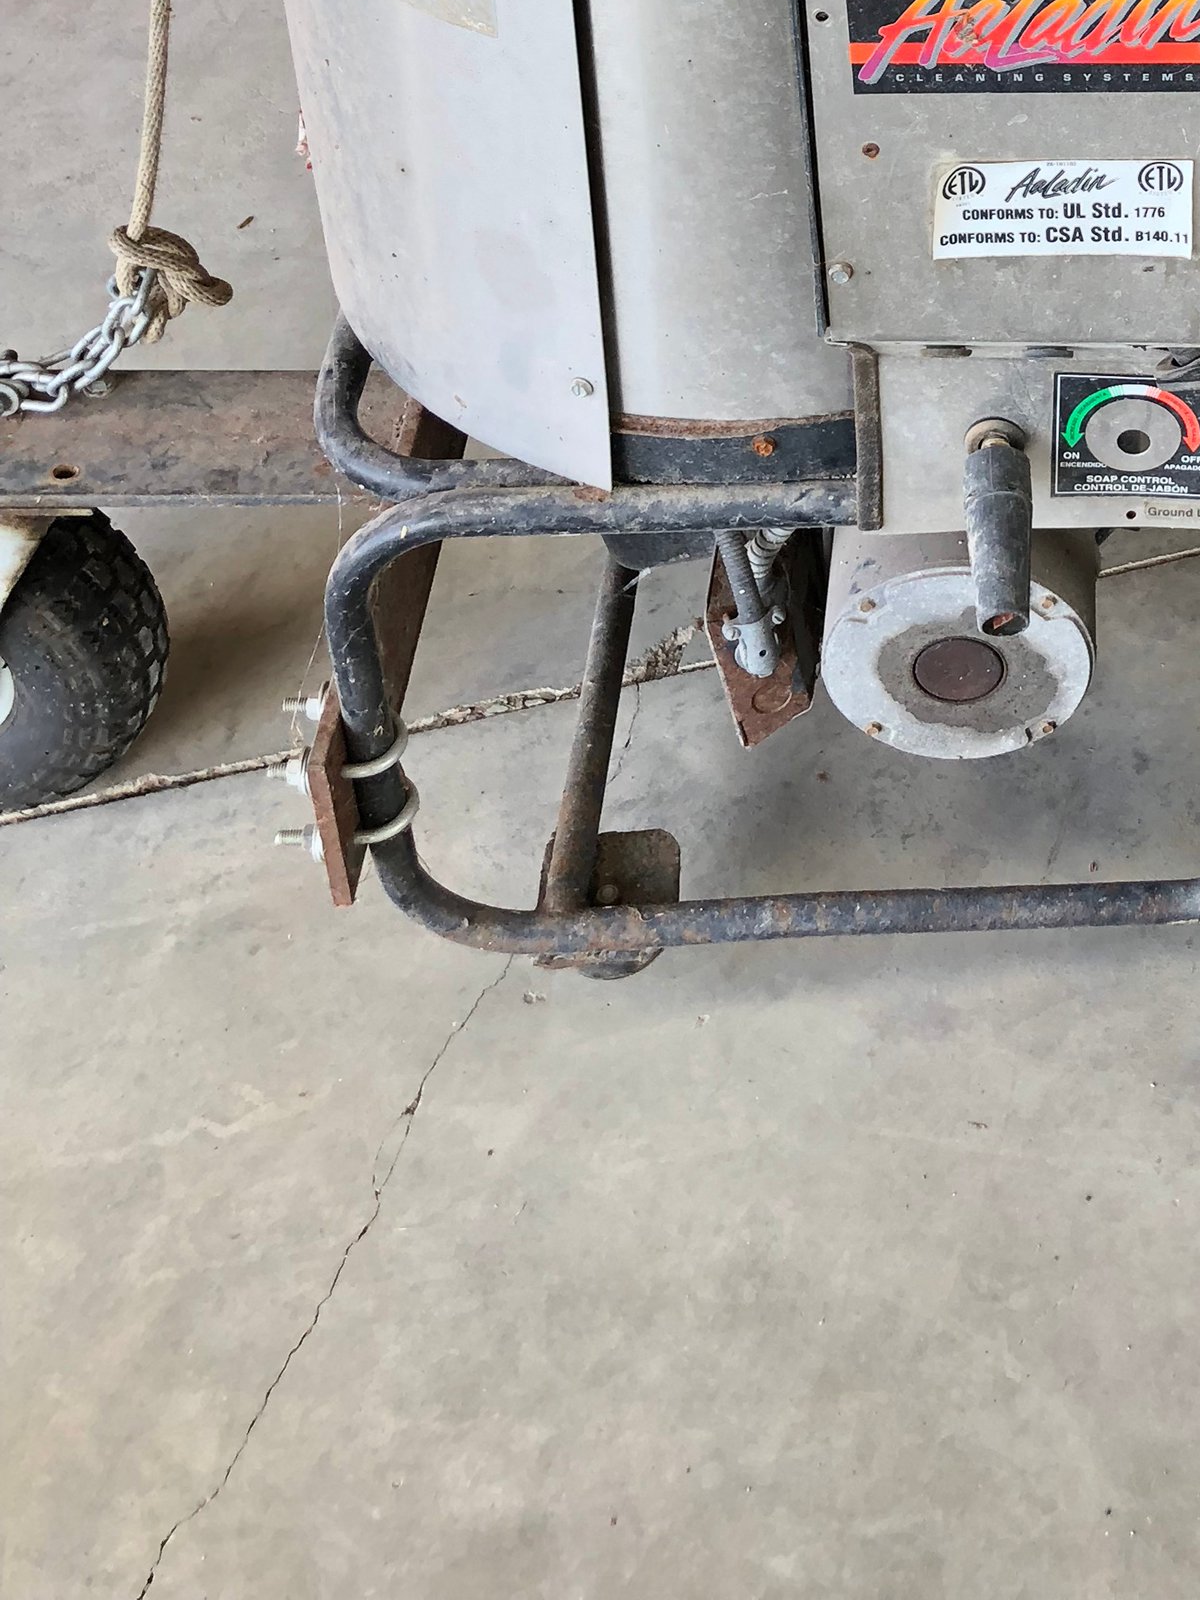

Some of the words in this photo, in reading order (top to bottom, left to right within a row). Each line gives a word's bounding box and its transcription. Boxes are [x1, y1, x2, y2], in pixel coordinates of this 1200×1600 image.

[895, 73, 1045, 83] CLEANING
[1063, 72, 1194, 82] SYSTEMS
[944, 167, 983, 197] ETL
[1142, 164, 1180, 191] ETL
[962, 208, 1034, 221] CONFORMS
[1039, 208, 1059, 220] TO:
[1063, 203, 1086, 219] UL
[1092, 203, 1129, 219] Std.
[1134, 207, 1165, 218] 1776
[939, 231, 1015, 246] CONFORMS
[1019, 231, 1041, 244] TO:
[1045, 226, 1085, 243] CSA
[1090, 226, 1129, 242] Std.
[1135, 231, 1189, 244] B140.11
[1063, 451, 1080, 460] ON
[1086, 474, 1118, 483] SOAP
[1120, 475, 1176, 485] CONTROL
[1073, 483, 1128, 492] CONTROL
[1131, 484, 1147, 492] DE
[1150, 484, 1189, 494] JABÓN
[1147, 507, 1193, 518] Ground
